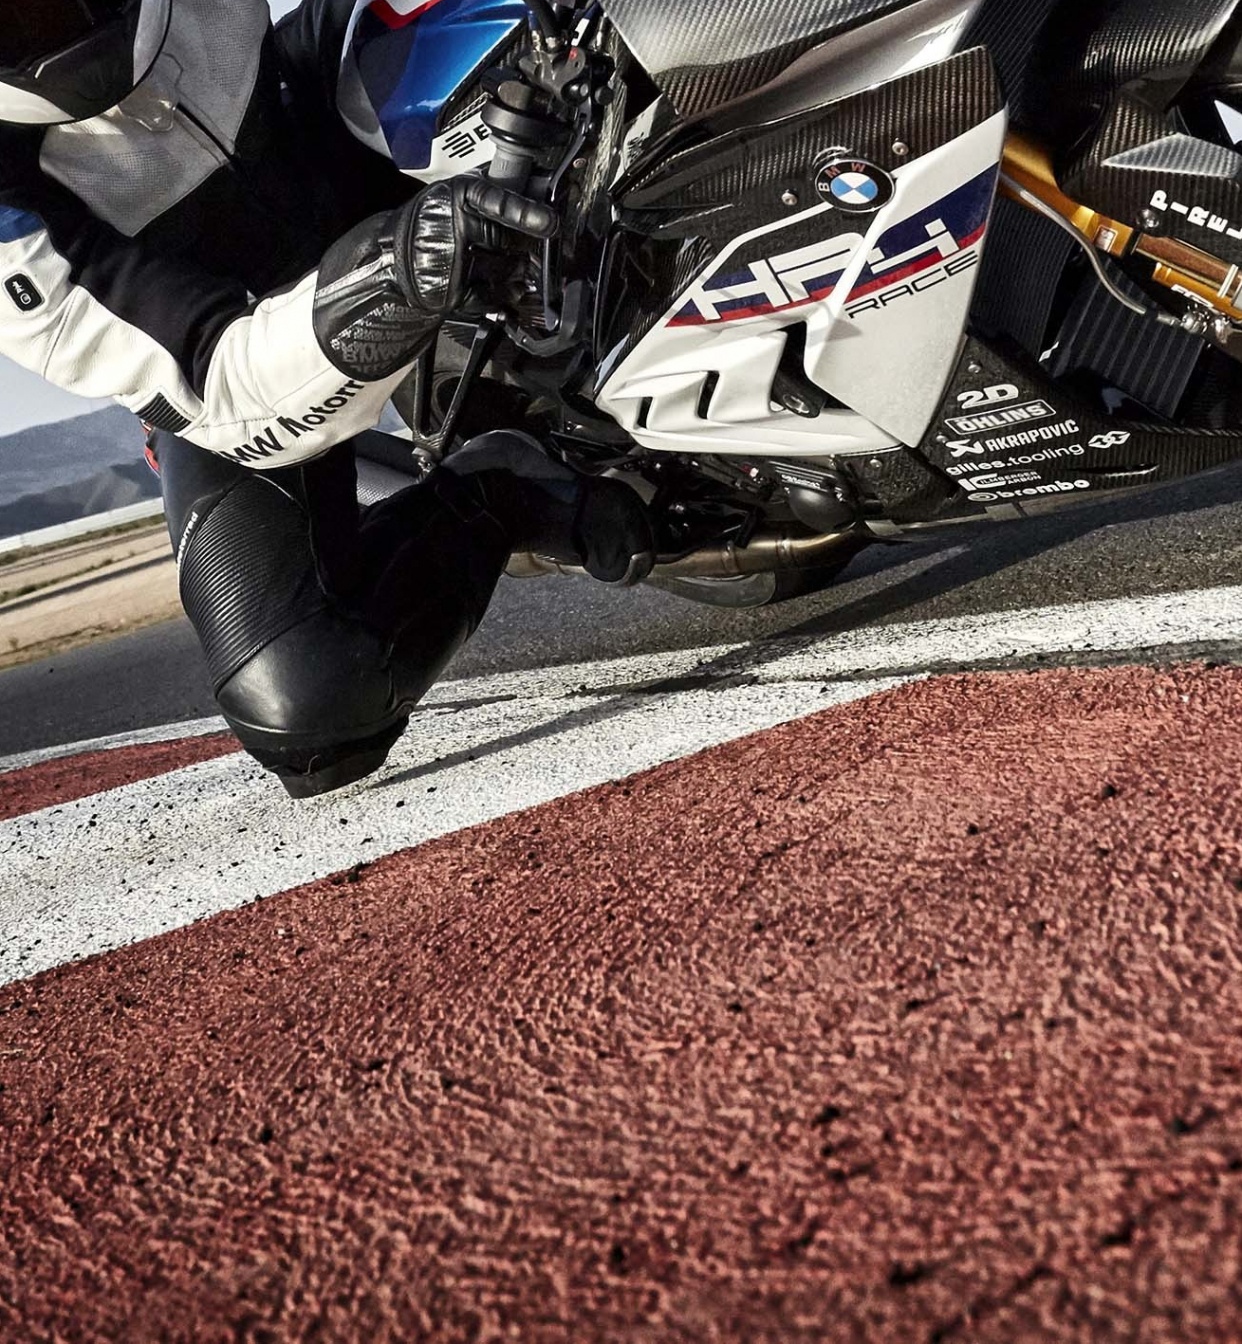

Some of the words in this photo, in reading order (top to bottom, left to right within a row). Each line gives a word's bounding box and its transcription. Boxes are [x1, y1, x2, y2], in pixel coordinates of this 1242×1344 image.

[818, 162, 866, 192] BMW
[689, 218, 960, 321] HP4
[845, 250, 979, 319] RACE
[957, 383, 1019, 409] 2D
[955, 402, 1048, 432] ÖHLINS
[945, 443, 1085, 476] gilles.tooling
[996, 479, 1091, 499] brembo
